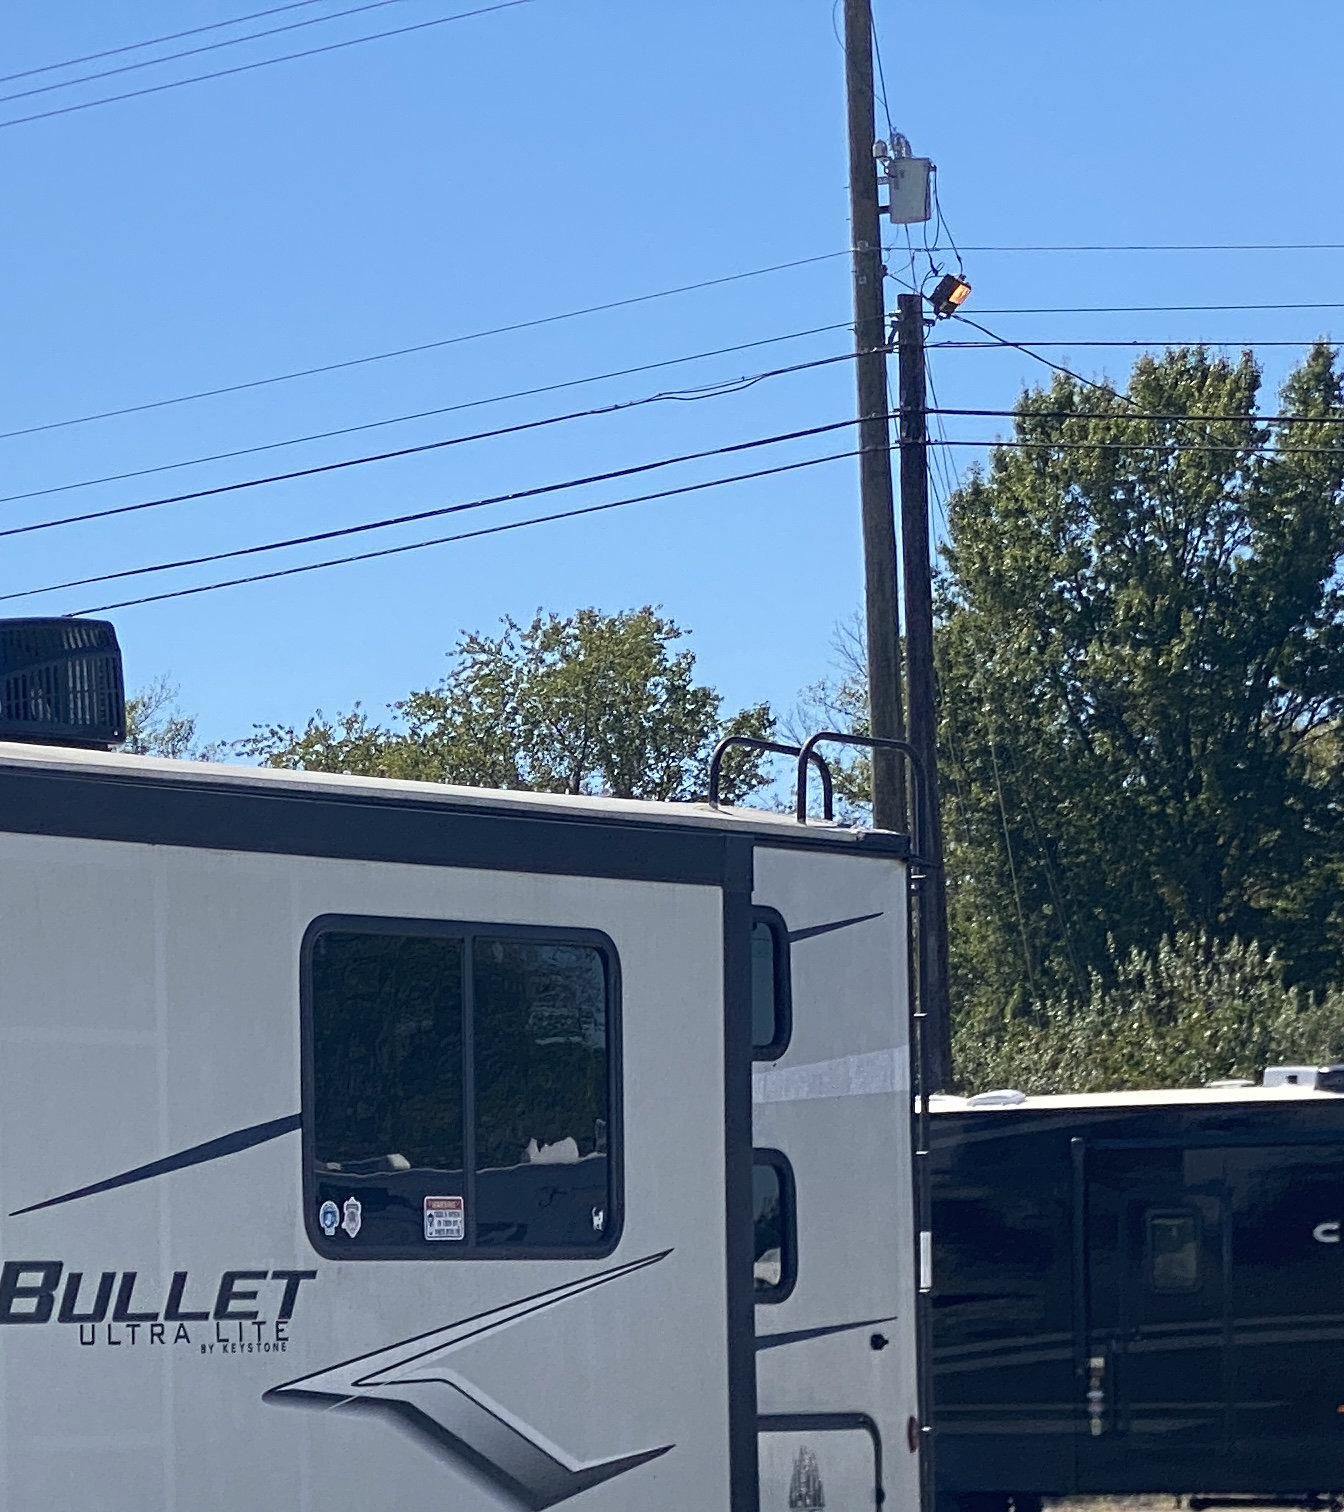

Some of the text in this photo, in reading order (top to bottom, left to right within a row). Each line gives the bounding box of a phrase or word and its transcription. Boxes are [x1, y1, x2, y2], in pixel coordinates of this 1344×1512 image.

[79, 1321, 290, 1346] ULTRA LITE
[200, 1342, 287, 1354] BY KEYSTONE
